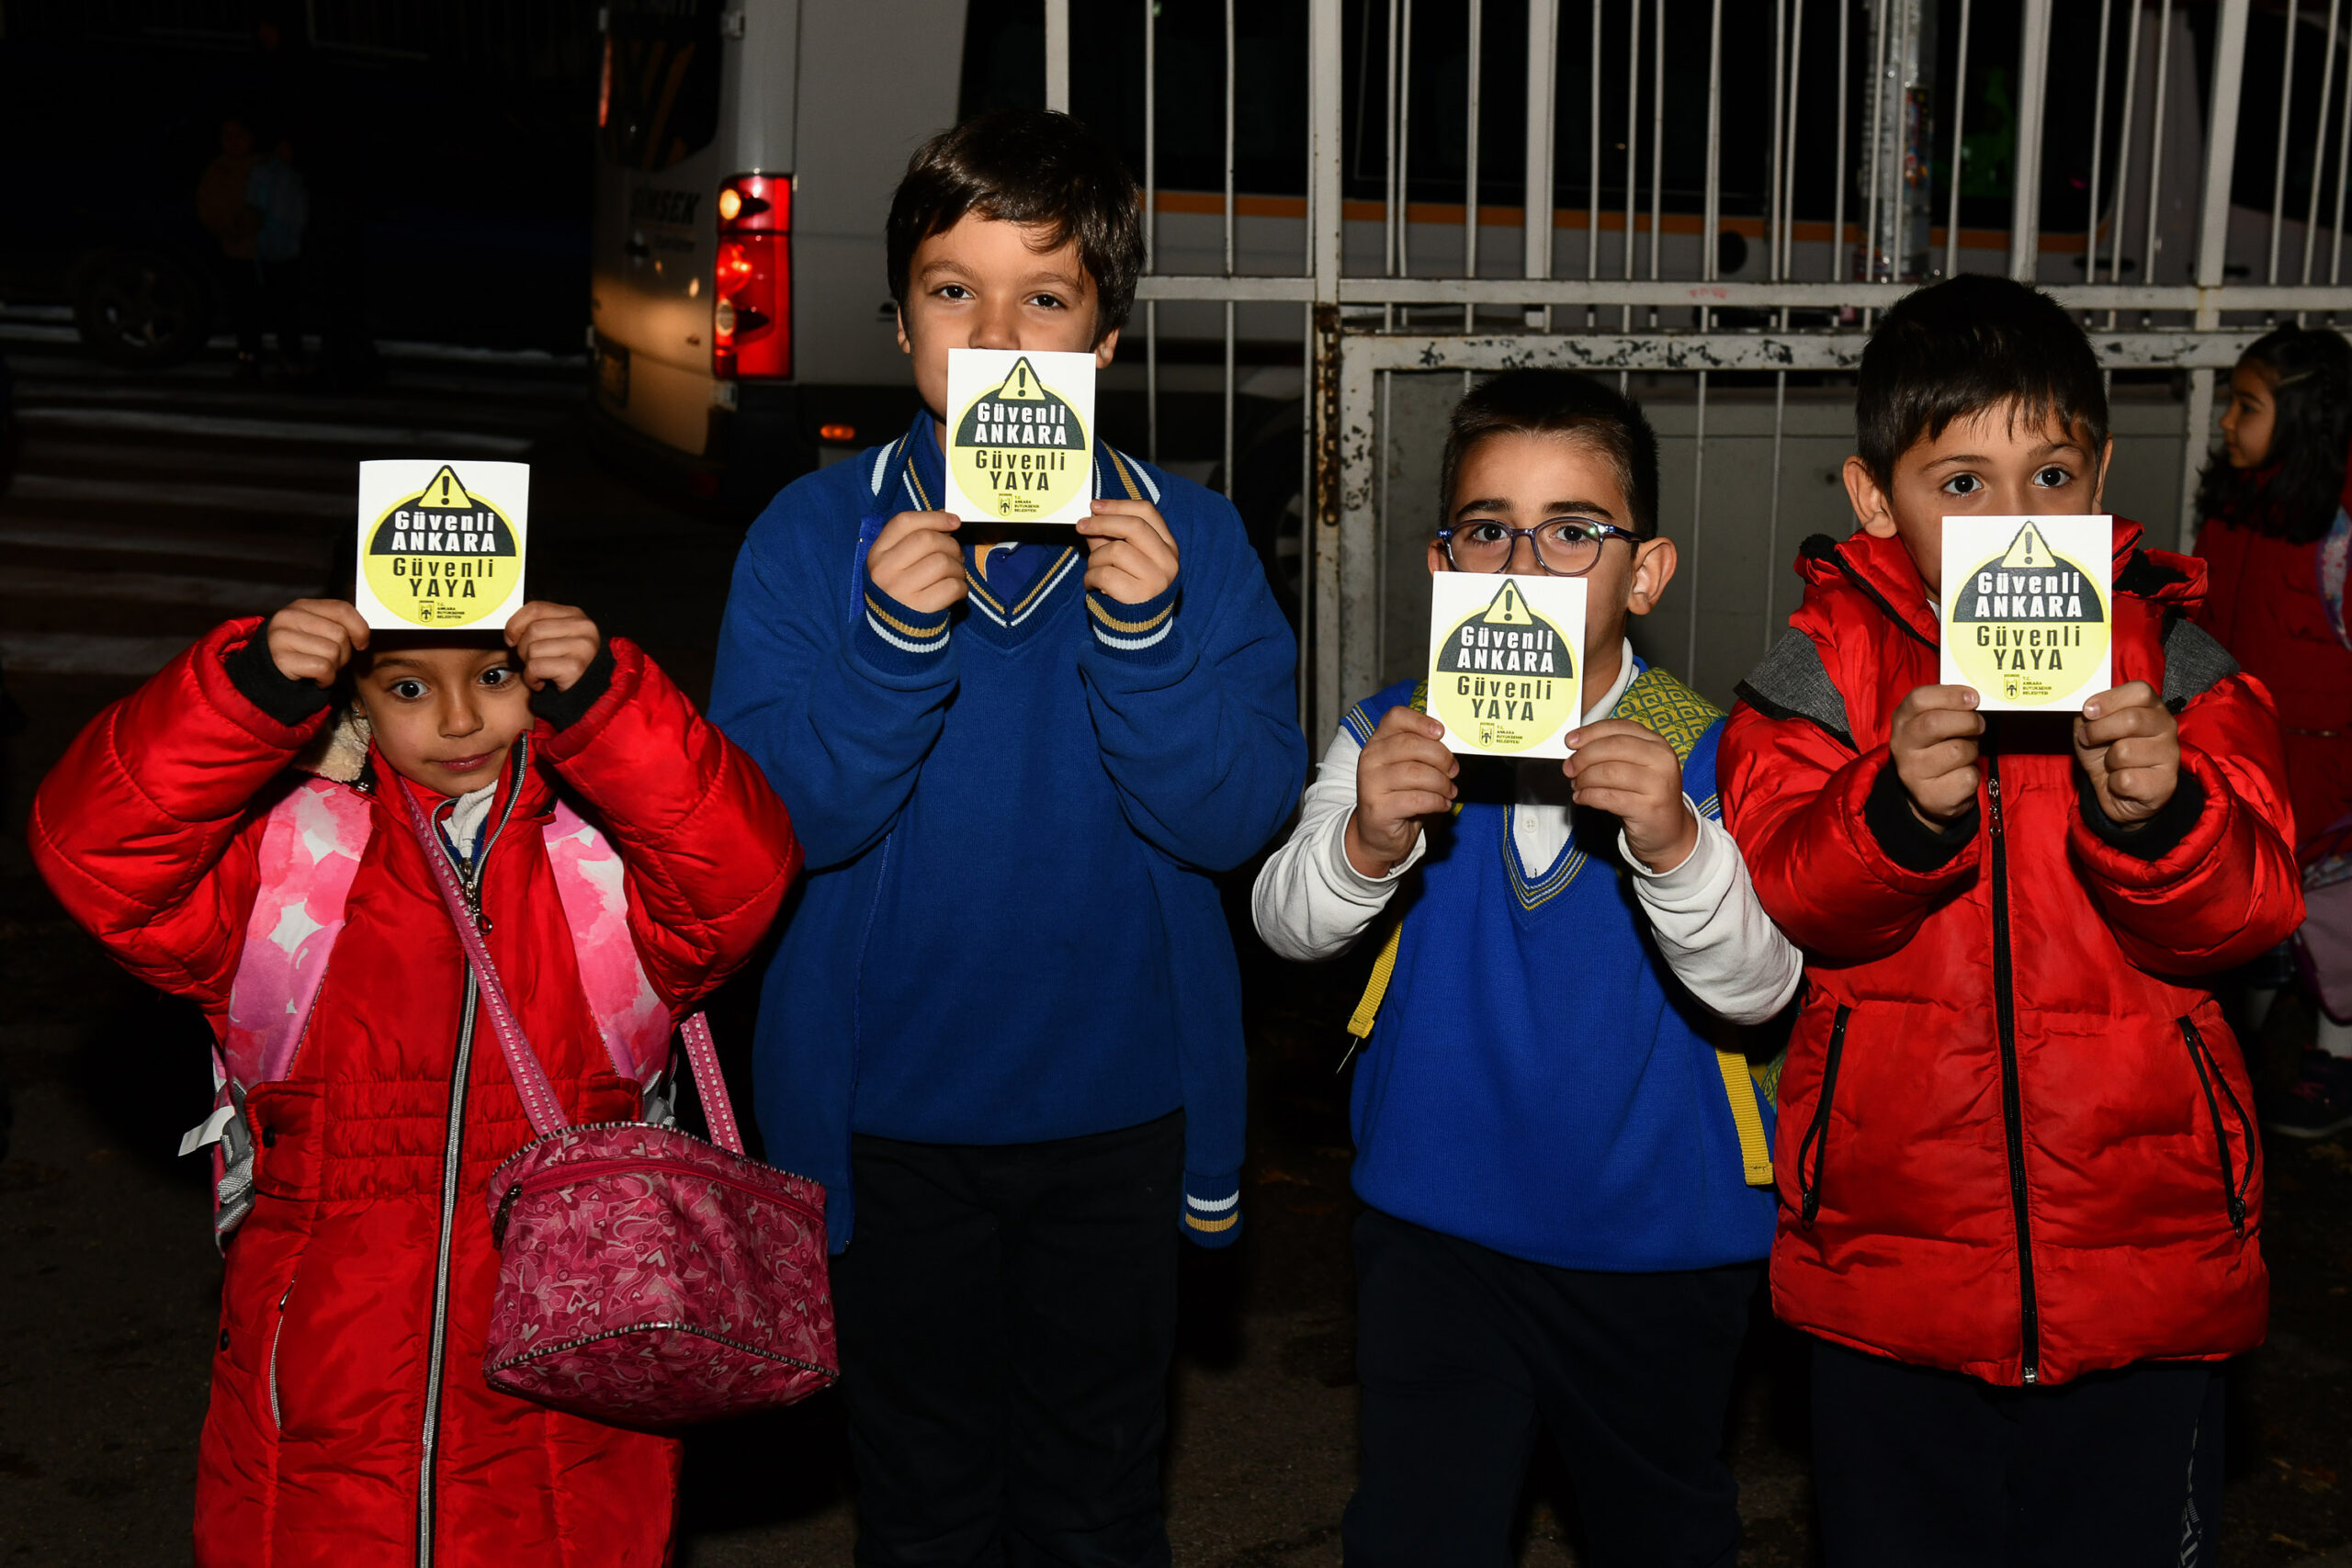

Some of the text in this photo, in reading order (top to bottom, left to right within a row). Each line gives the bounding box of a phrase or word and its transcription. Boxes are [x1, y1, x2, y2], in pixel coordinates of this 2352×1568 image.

[977, 402, 1066, 424] Güvenli
[974, 423, 1068, 446] ANKARA
[976, 450, 1065, 470] Güvenli
[989, 471, 1049, 491] YAYA
[394, 511, 495, 532] Güvenli
[391, 532, 496, 552] ANKARA
[393, 558, 493, 578] Güvenli
[409, 578, 476, 598] YAYA
[1977, 572, 2080, 594] Güvenli
[1975, 595, 2083, 617] ANKARA
[1461, 626, 1554, 650] Güvenli
[1977, 626, 2080, 647] Güvenli
[1457, 648, 1555, 672] ANKARA
[1993, 649, 2063, 670] YAYA
[1457, 675, 1552, 700] Güvenli
[1471, 698, 1534, 721] YAYA
